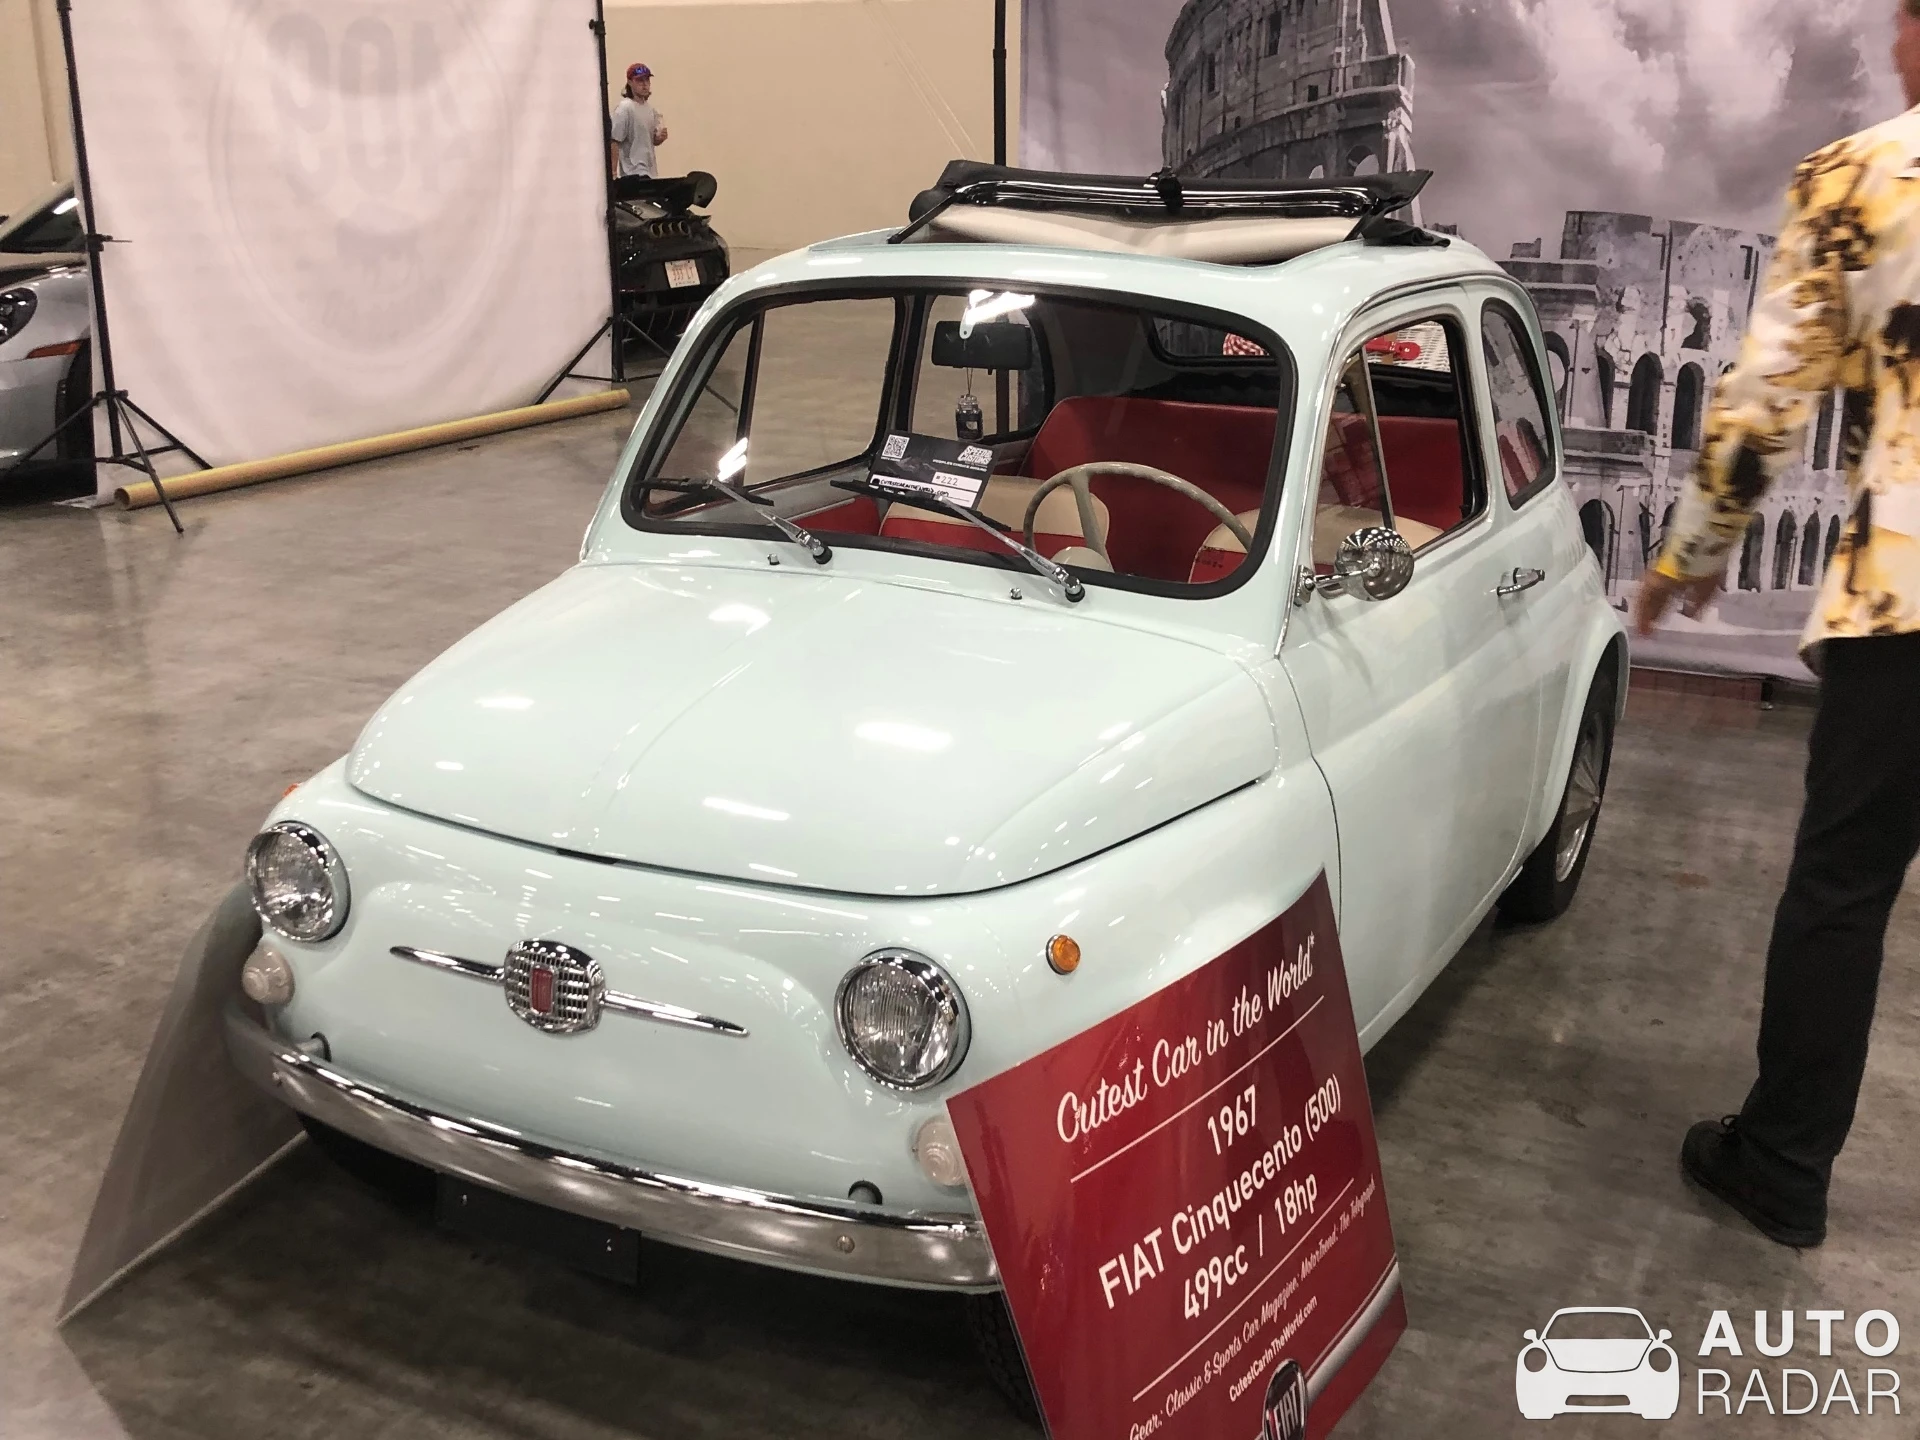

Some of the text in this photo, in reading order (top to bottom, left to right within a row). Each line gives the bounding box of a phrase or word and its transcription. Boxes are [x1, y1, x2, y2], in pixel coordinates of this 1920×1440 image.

[940, 475, 959, 487] 222
[1057, 1056, 1148, 1143] Cutest
[1152, 1035, 1202, 1088] Car
[1206, 1019, 1229, 1056] in
[1231, 984, 1263, 1037] the
[1207, 1084, 1256, 1155] 1967
[1098, 1073, 1341, 1310] FIAT Cinquecento (500)
[1184, 1244, 1249, 1320] 499cc
[1274, 1174, 1318, 1235] 18hp
[1166, 1375, 1203, 1418] Classic
[1204, 1360, 1212, 1384] &
[1213, 1335, 1242, 1376] Sports
[1243, 1317, 1260, 1344] Car
[1340, 1211, 1351, 1234] The
[1229, 1295, 1318, 1402] CutestCarInTheWorld.com
[1273, 1381, 1299, 1440] FIAT
